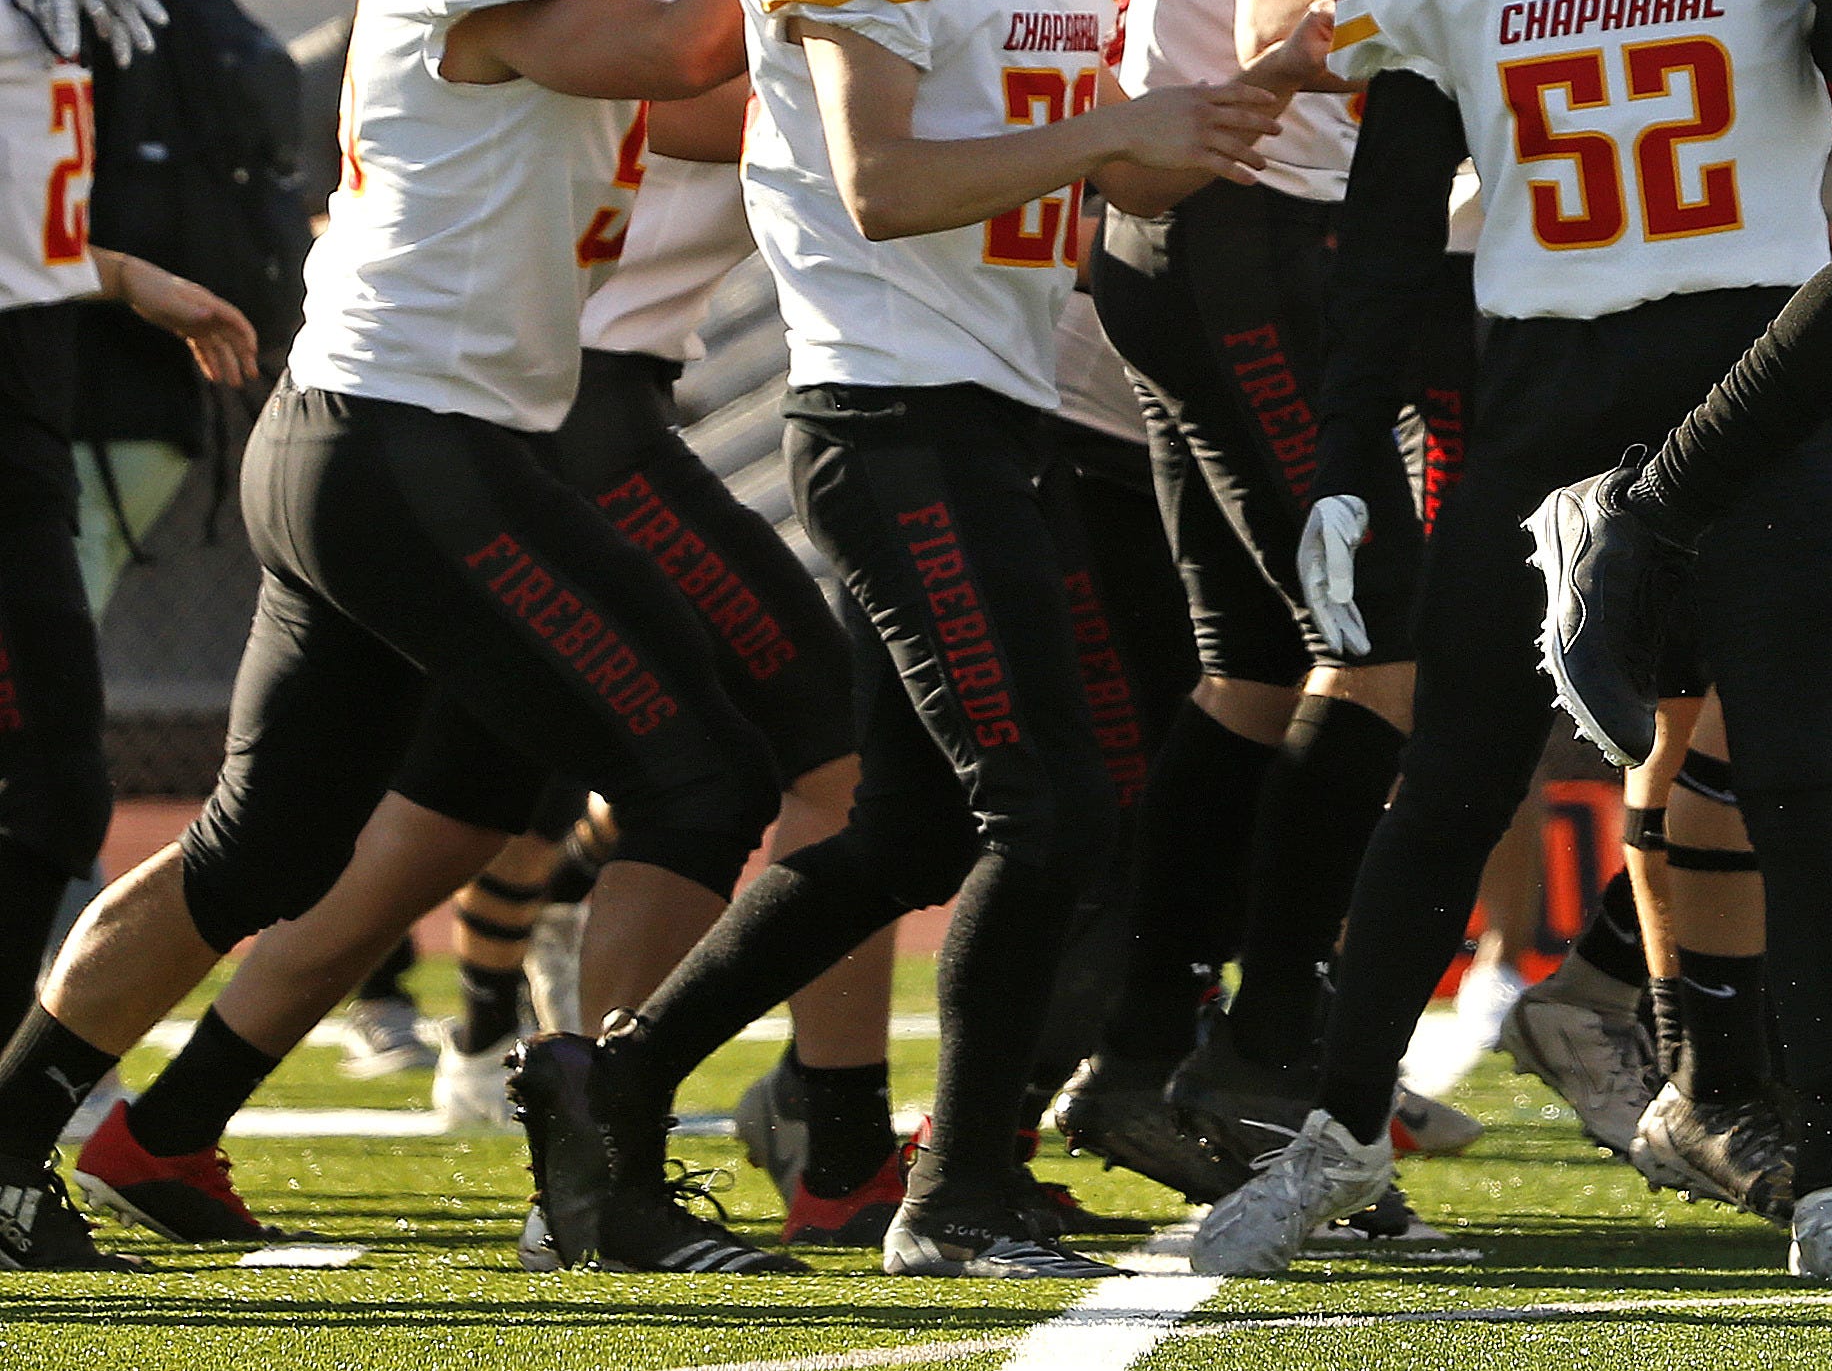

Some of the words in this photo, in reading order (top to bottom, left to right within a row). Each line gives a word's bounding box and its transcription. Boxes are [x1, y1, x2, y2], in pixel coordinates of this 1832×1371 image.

[1497, 34, 1745, 252] 52
[464, 532, 679, 736] FIREBIRDS
[597, 472, 797, 680] FIREBIRDS
[898, 502, 1021, 748] FIREBIRDS
